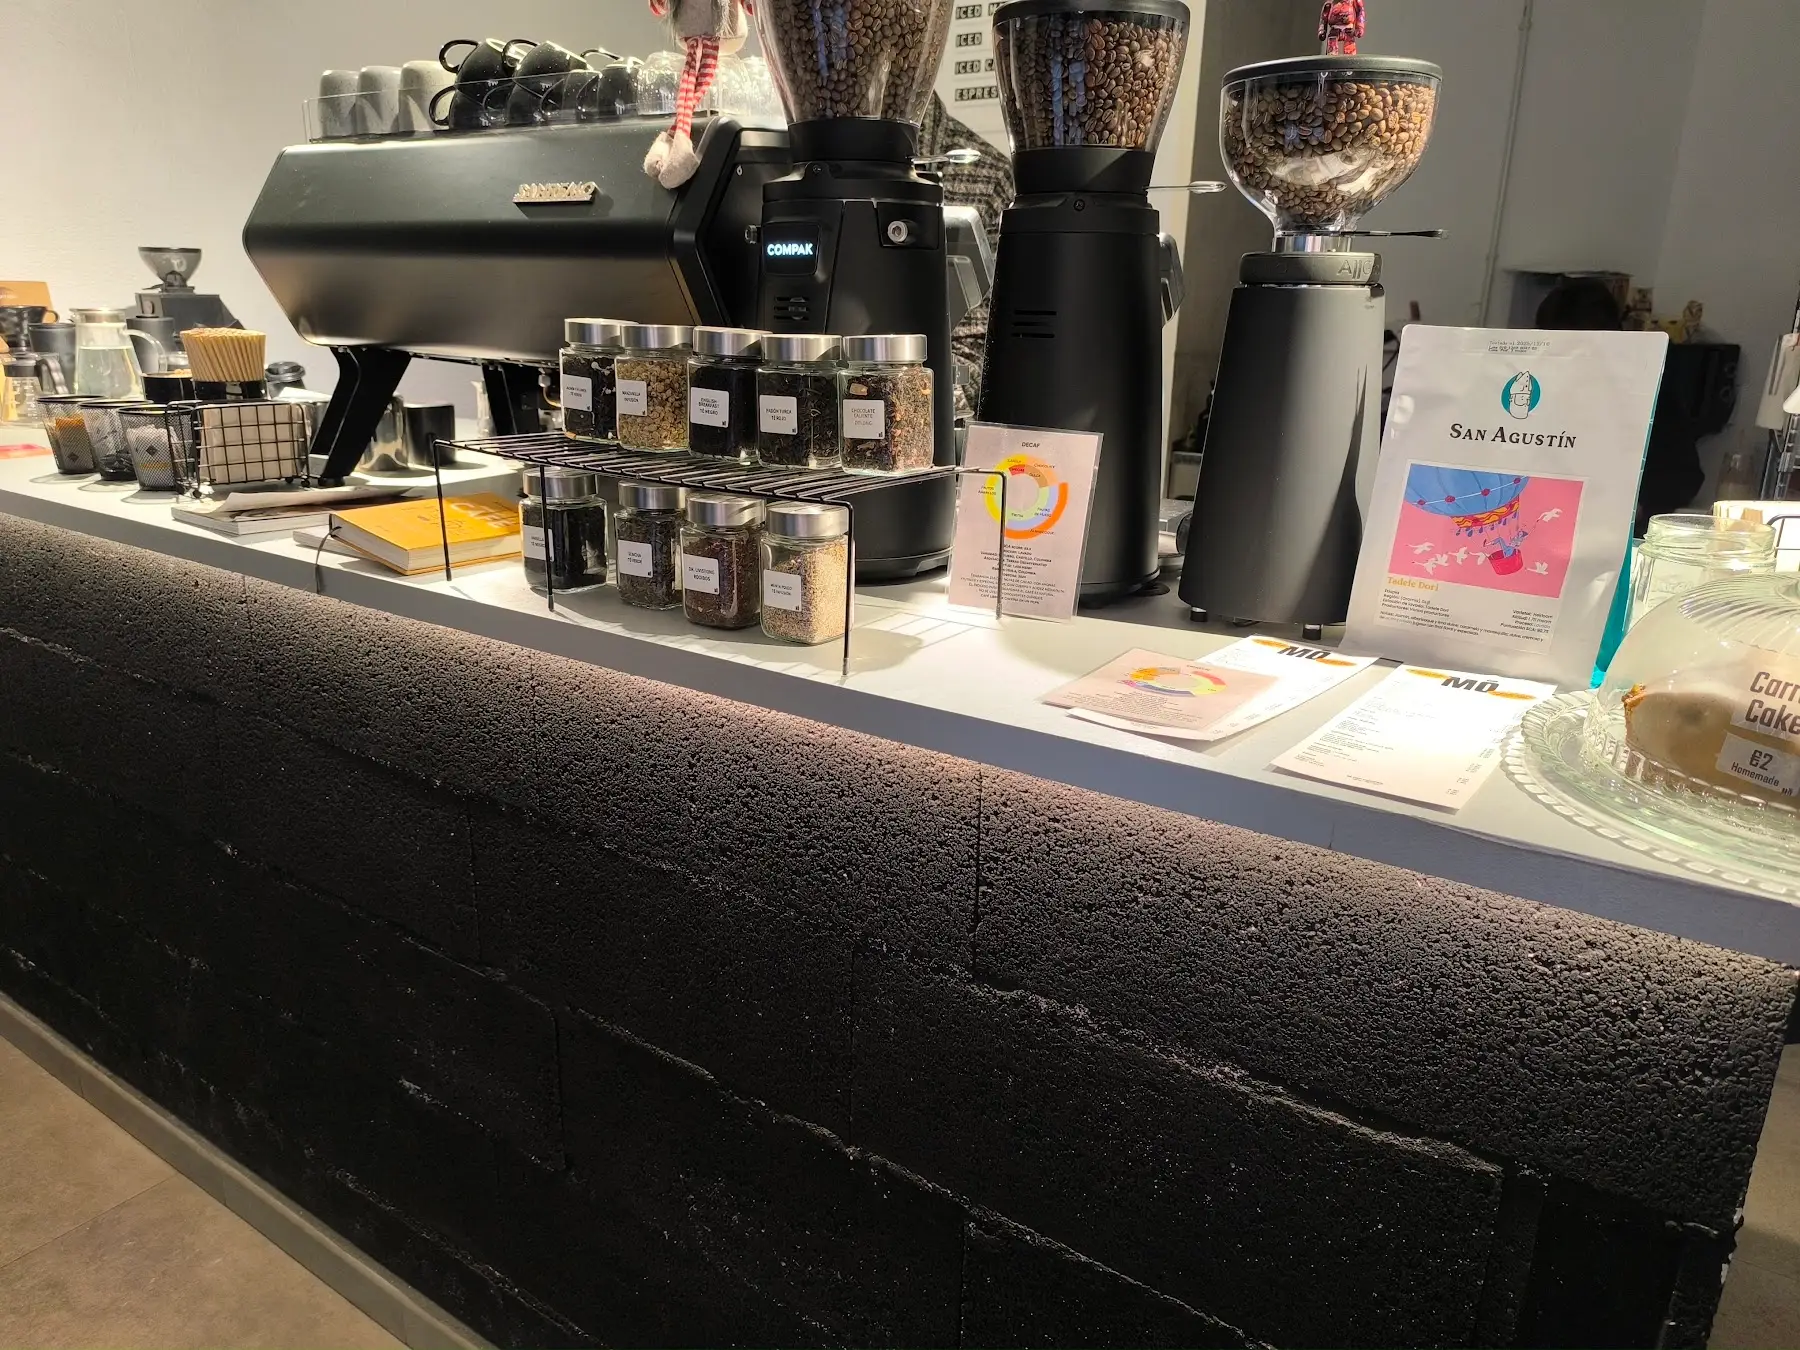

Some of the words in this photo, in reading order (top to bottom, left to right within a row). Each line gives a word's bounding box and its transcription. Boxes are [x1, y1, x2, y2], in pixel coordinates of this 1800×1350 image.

[956, 5, 982, 19] ICED
[956, 33, 982, 47] ICED
[955, 60, 981, 75] ICED
[955, 86, 999, 101] ESPRES
[767, 243, 813, 256] COMPAK
[1387, 576, 1416, 588] Tadele
[1418, 581, 1440, 592] Dori
[1750, 671, 1800, 704] Carr
[1749, 749, 1774, 771] €2
[1730, 761, 1780, 787] Homemade
